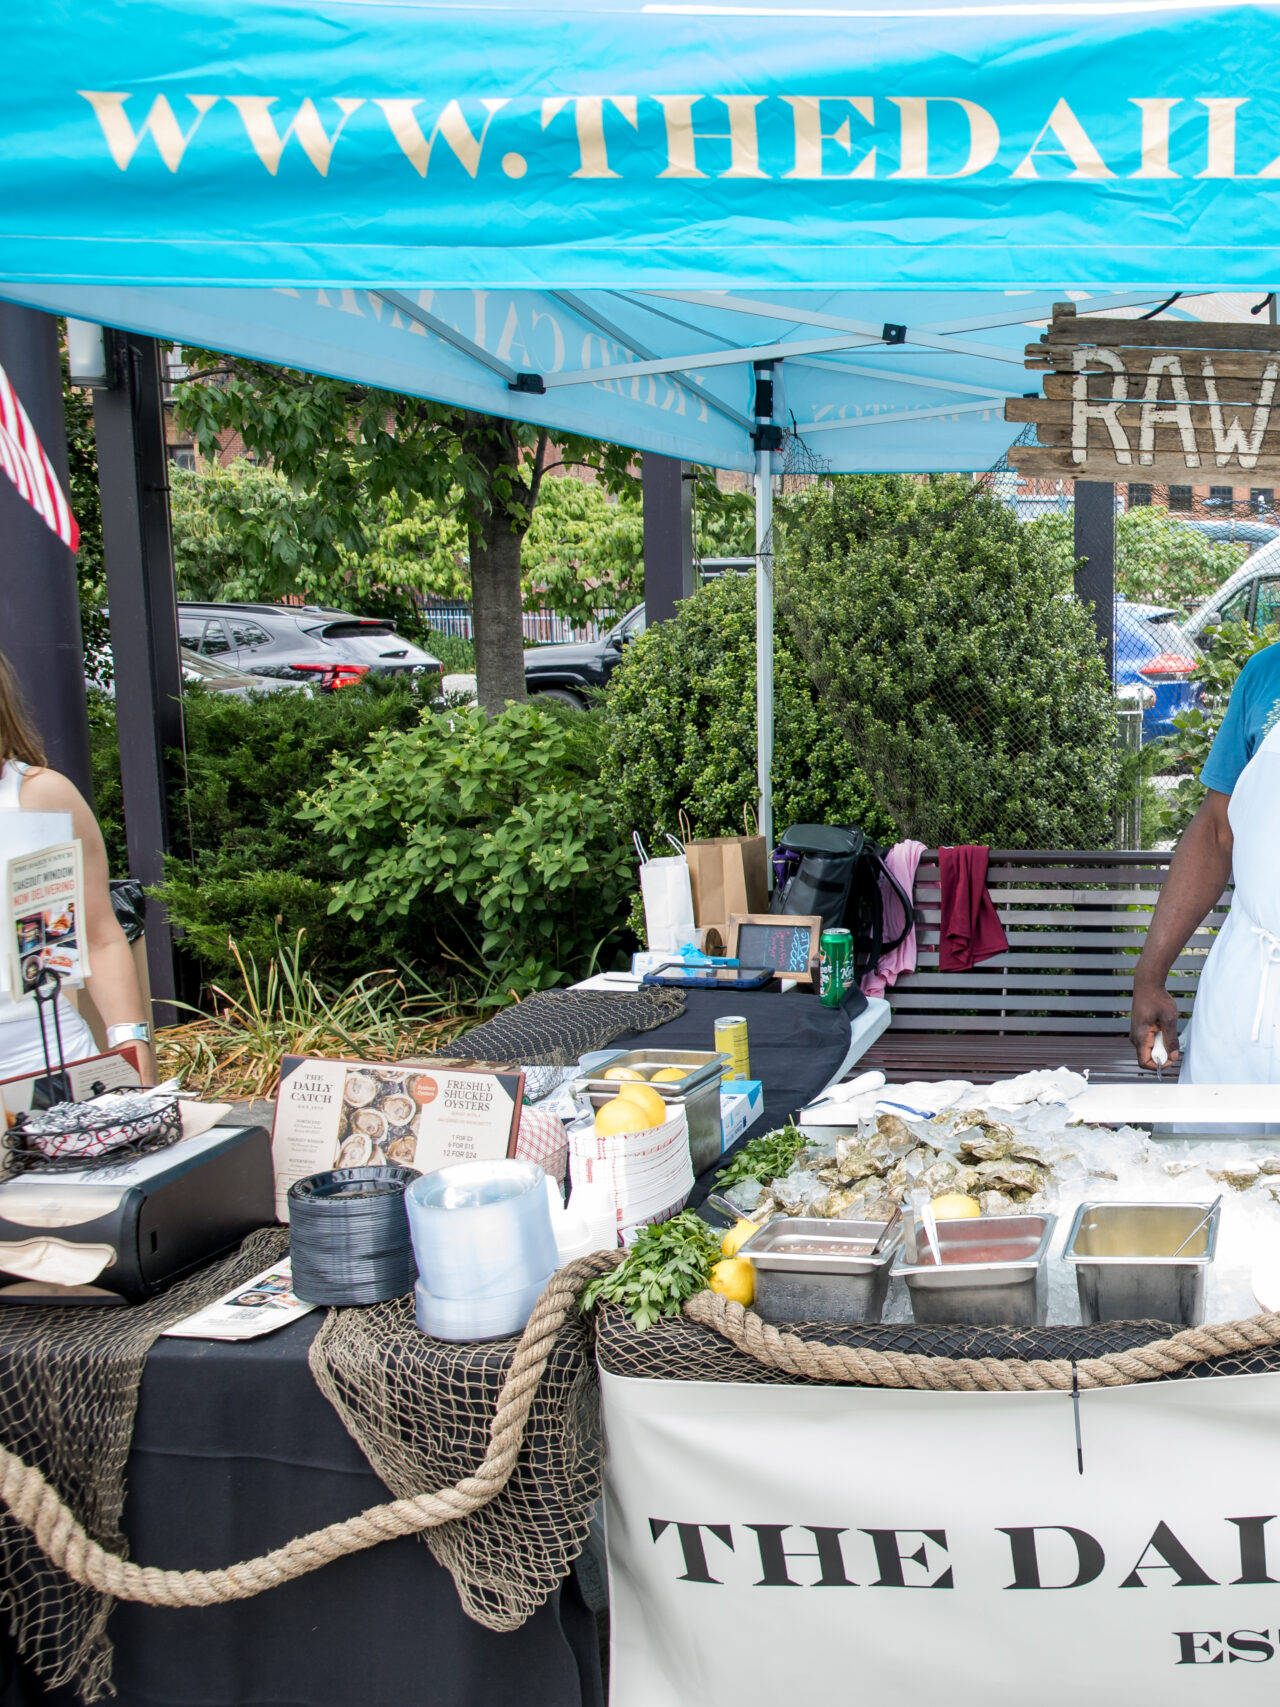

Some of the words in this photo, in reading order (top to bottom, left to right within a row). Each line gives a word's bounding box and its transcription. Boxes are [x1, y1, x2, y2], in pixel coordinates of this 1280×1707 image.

[305, 1073, 324, 1082] THE
[293, 1081, 333, 1093] DAILY
[447, 1079, 493, 1092] FRESHLY
[291, 1092, 332, 1104] CATCH
[444, 1089, 493, 1102] SHUCKED
[444, 1100, 490, 1112] OYSTERS
[451, 1150, 464, 1158] FOR
[648, 1517, 954, 1589] THE
